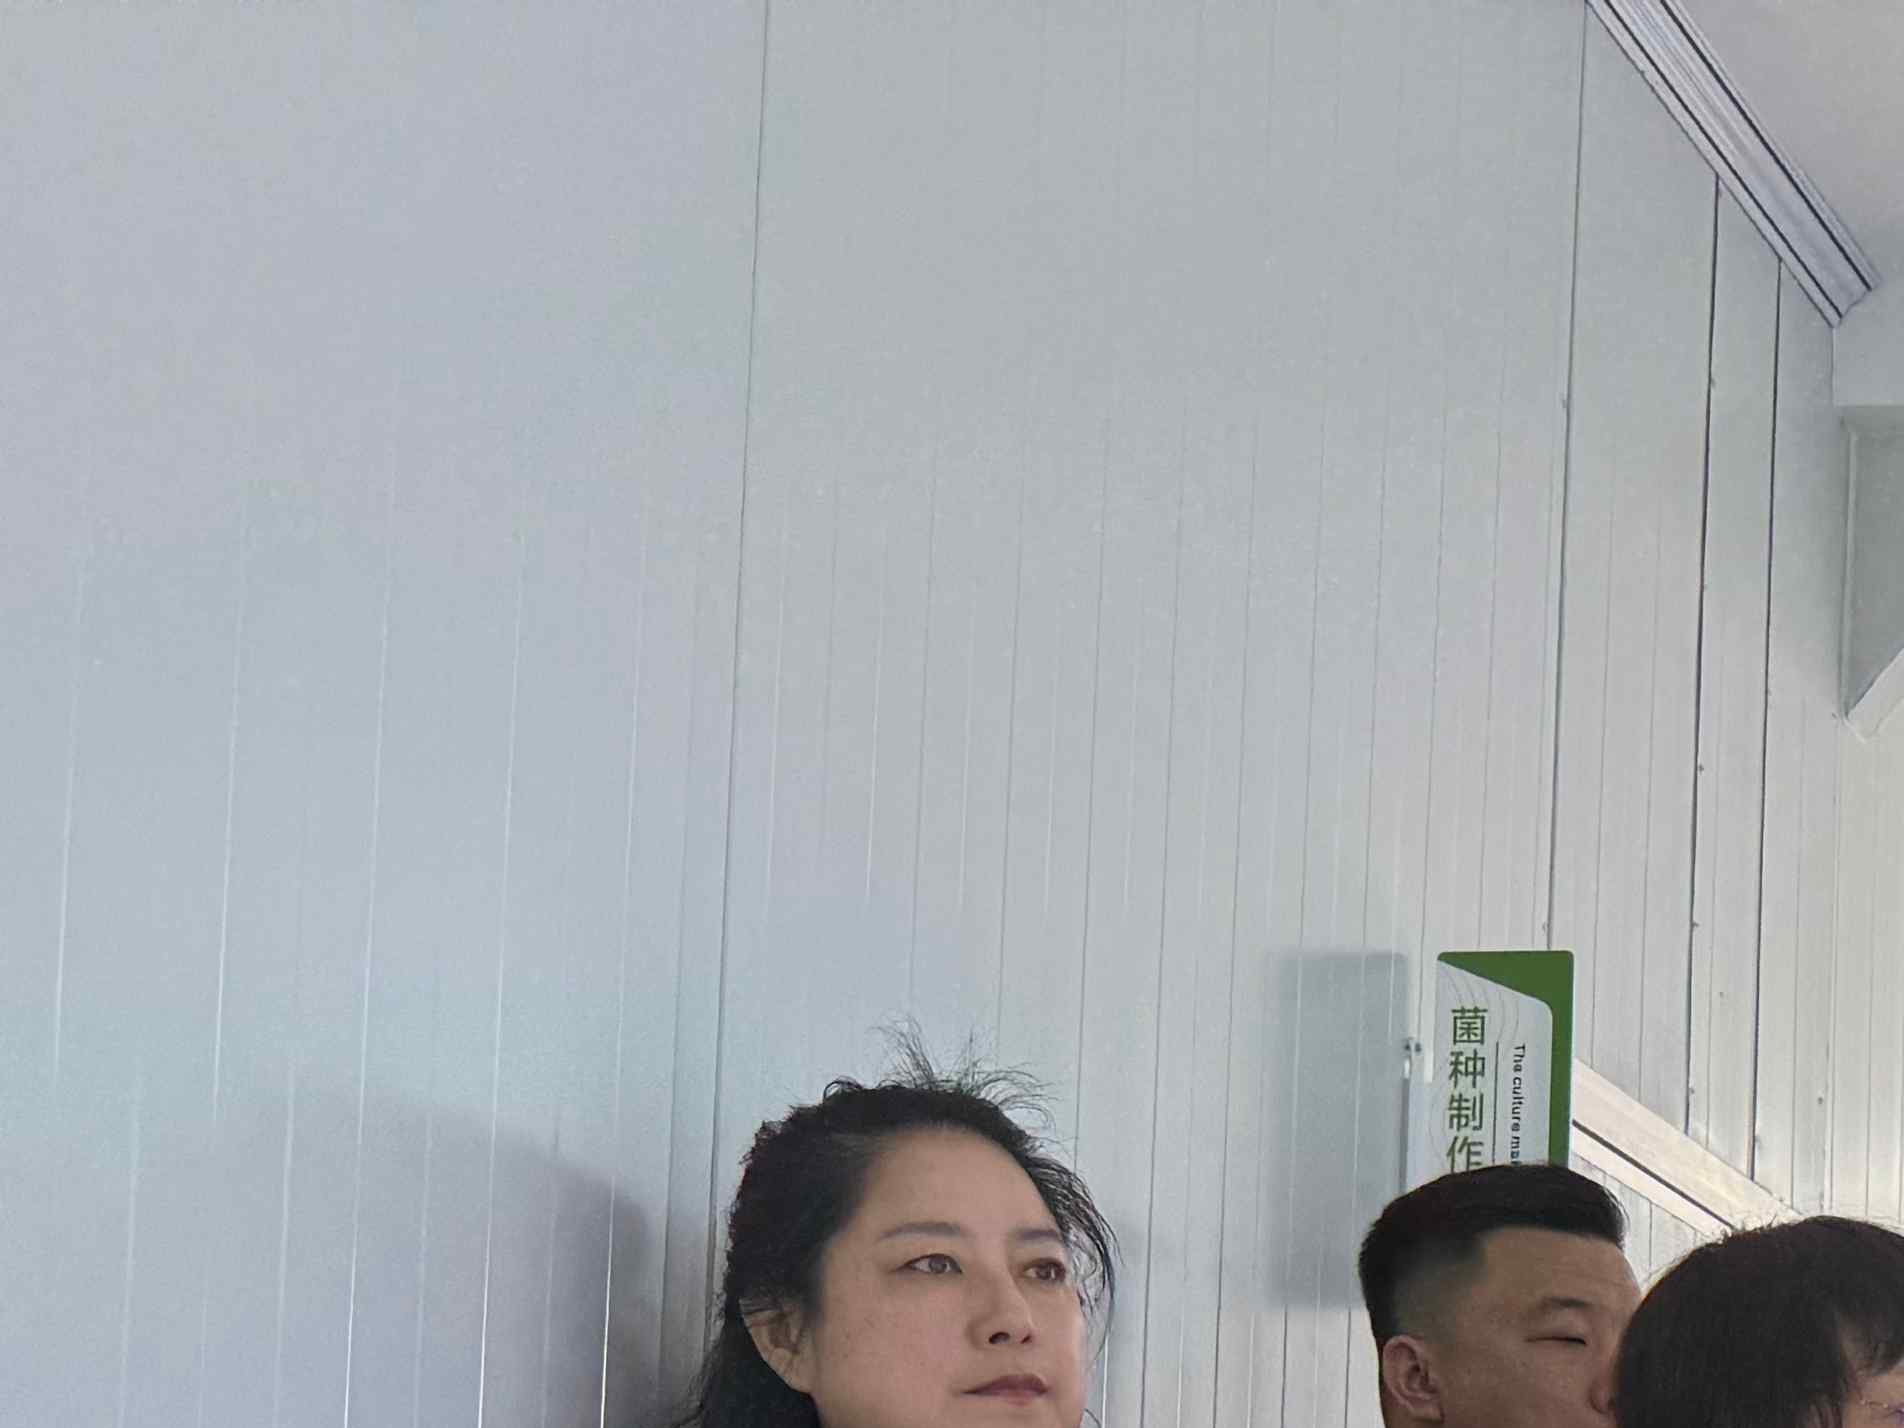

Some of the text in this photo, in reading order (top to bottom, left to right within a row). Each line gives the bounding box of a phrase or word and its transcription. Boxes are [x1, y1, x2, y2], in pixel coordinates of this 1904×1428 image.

[1513, 1044, 1525, 1072] The
[1446, 1006, 1487, 1174] 菌种制作
[1511, 1077, 1524, 1132] culture
